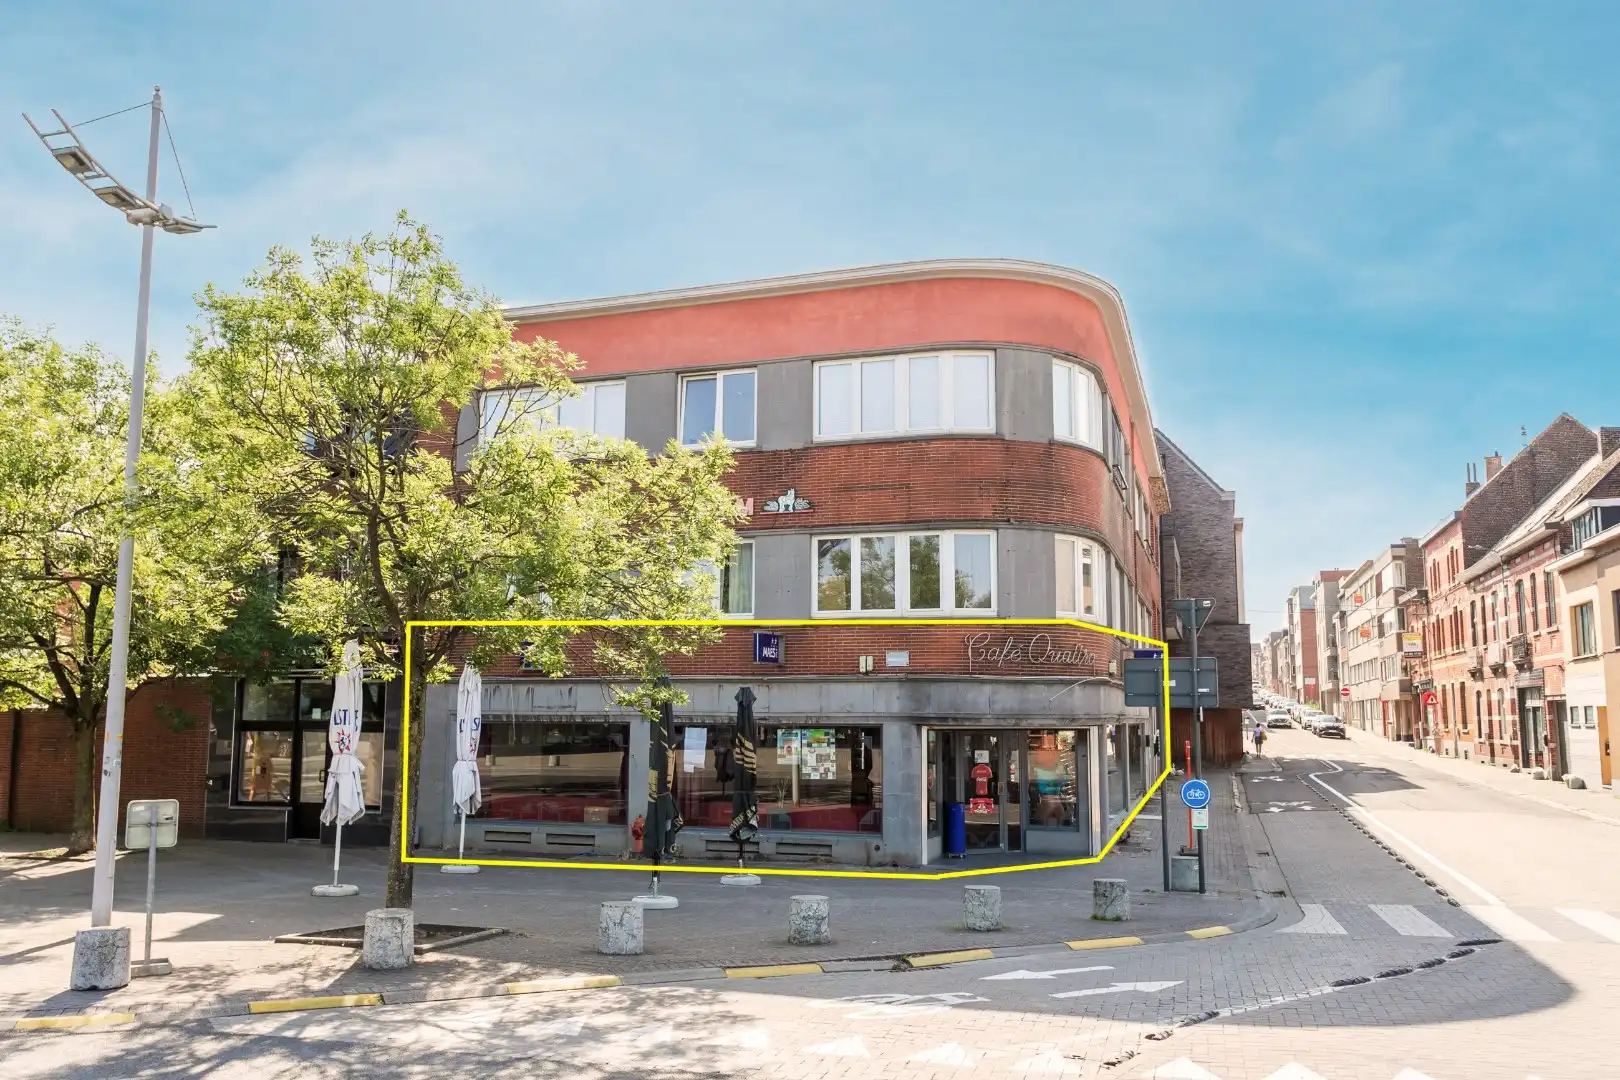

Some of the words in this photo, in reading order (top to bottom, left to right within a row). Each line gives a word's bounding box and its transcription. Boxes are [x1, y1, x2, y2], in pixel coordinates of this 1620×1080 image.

[762, 646, 776, 659] MAES
[964, 632, 1023, 668] Café
[1028, 633, 1096, 665] Quattro
